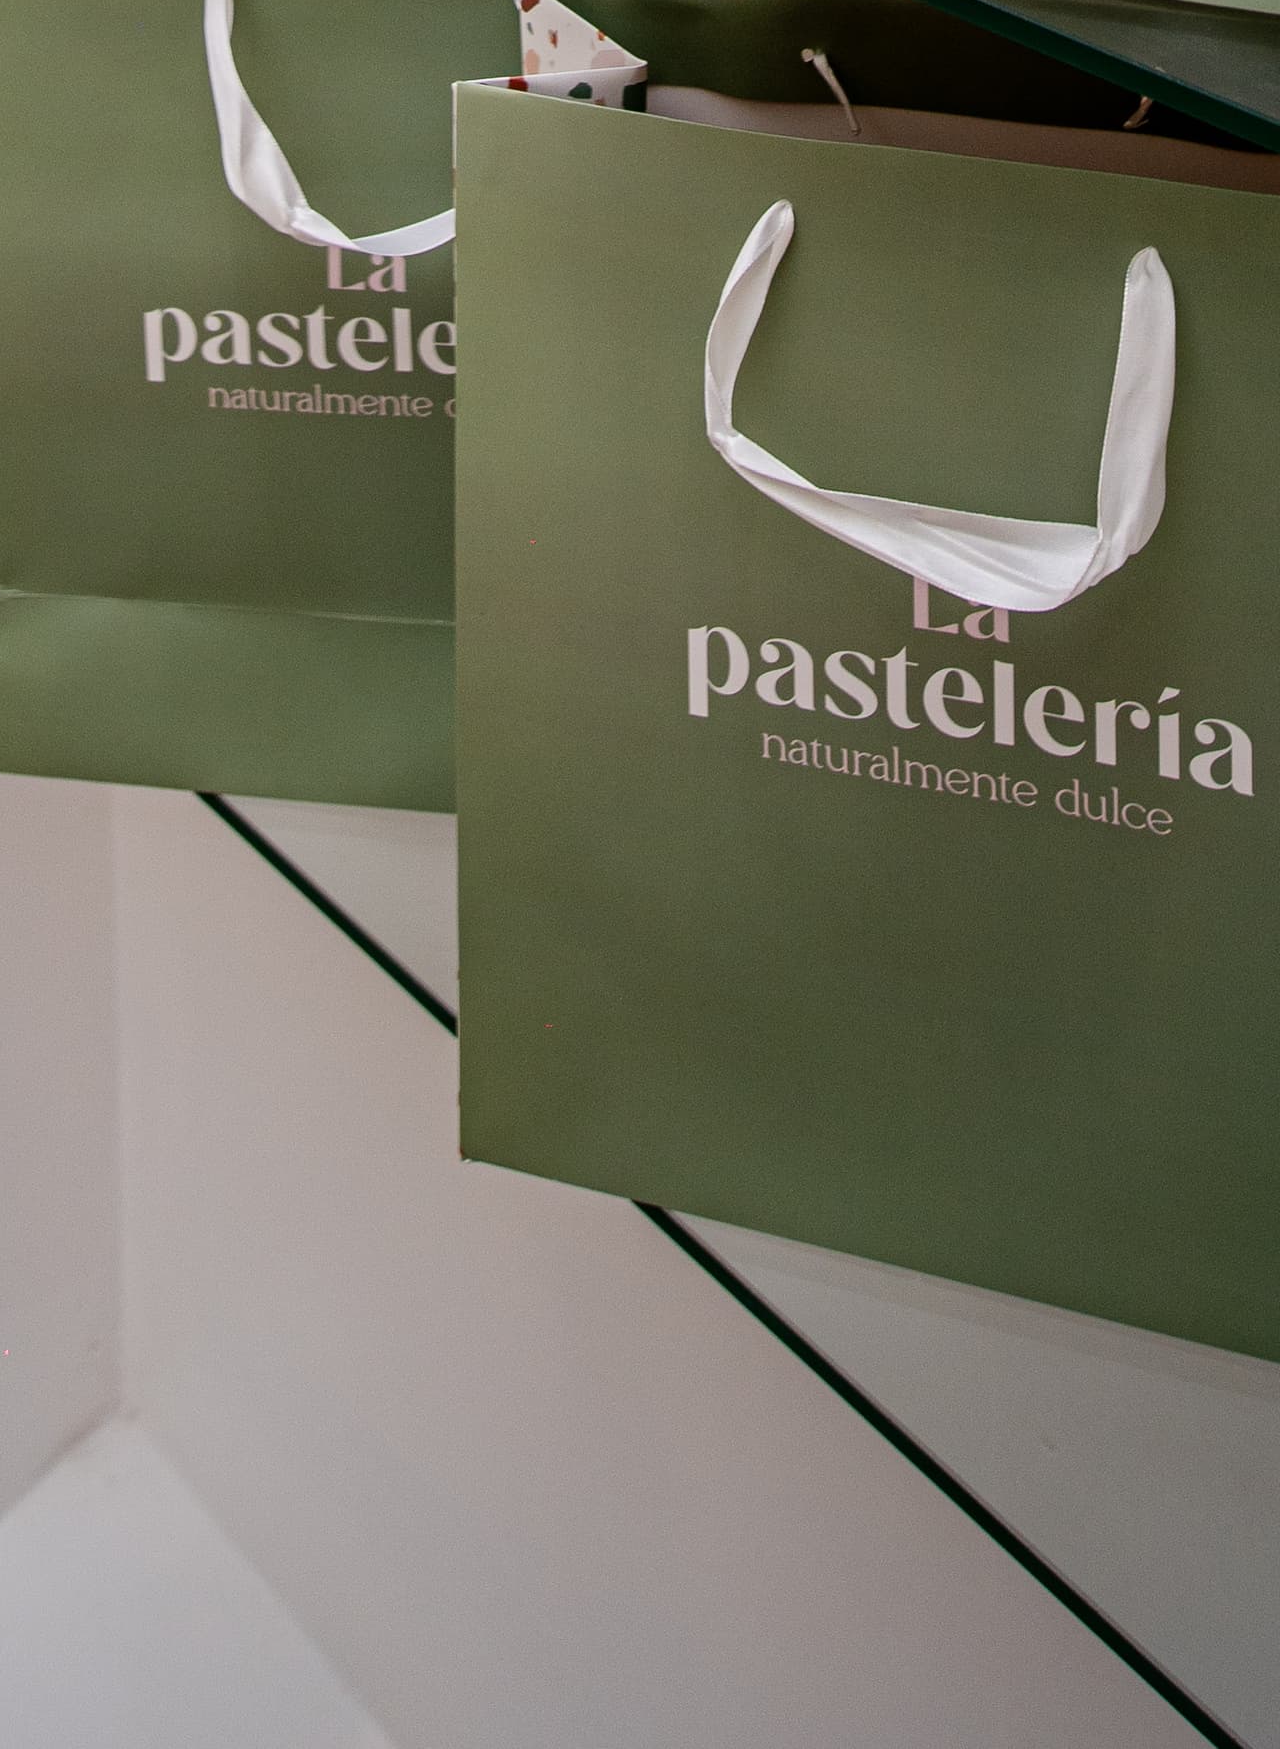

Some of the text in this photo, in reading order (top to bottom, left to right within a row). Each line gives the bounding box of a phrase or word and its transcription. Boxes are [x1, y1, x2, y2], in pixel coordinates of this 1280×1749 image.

[327, 244, 407, 293] La
[144, 305, 456, 382] pastele
[208, 384, 434, 418] naturalmente
[913, 575, 1010, 643] La
[687, 625, 1254, 797] pastelería
[761, 732, 1173, 835] naturalmente dulce
